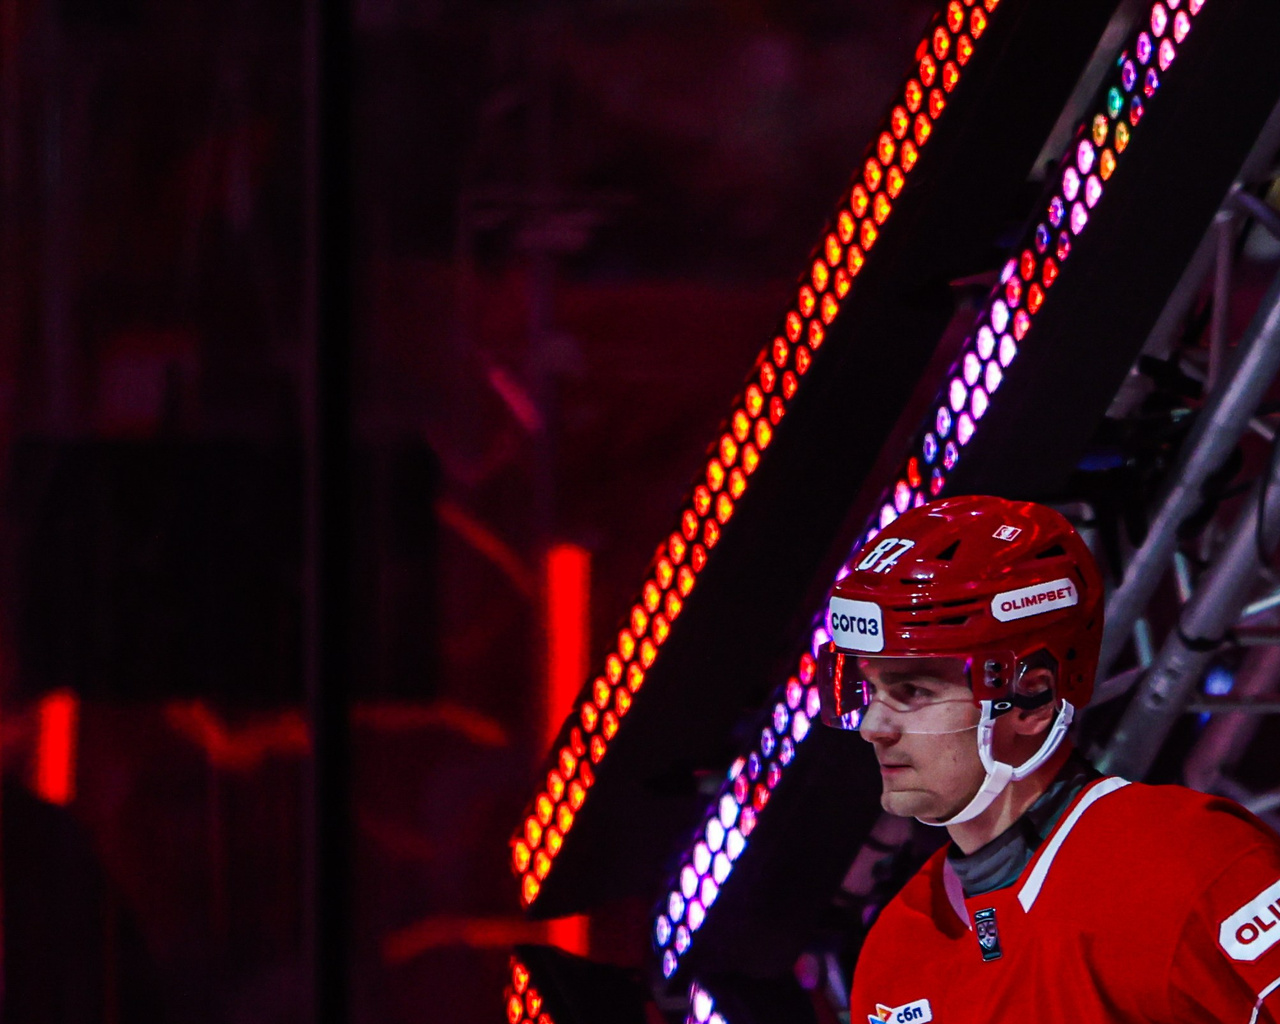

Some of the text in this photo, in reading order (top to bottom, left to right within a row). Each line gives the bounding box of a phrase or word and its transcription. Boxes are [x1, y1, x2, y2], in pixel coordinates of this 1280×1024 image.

[857, 538, 915, 573] 87
[1001, 587, 1072, 612] OLIMPBET
[831, 612, 879, 636] согаз
[896, 1006, 923, 1024] сбп
